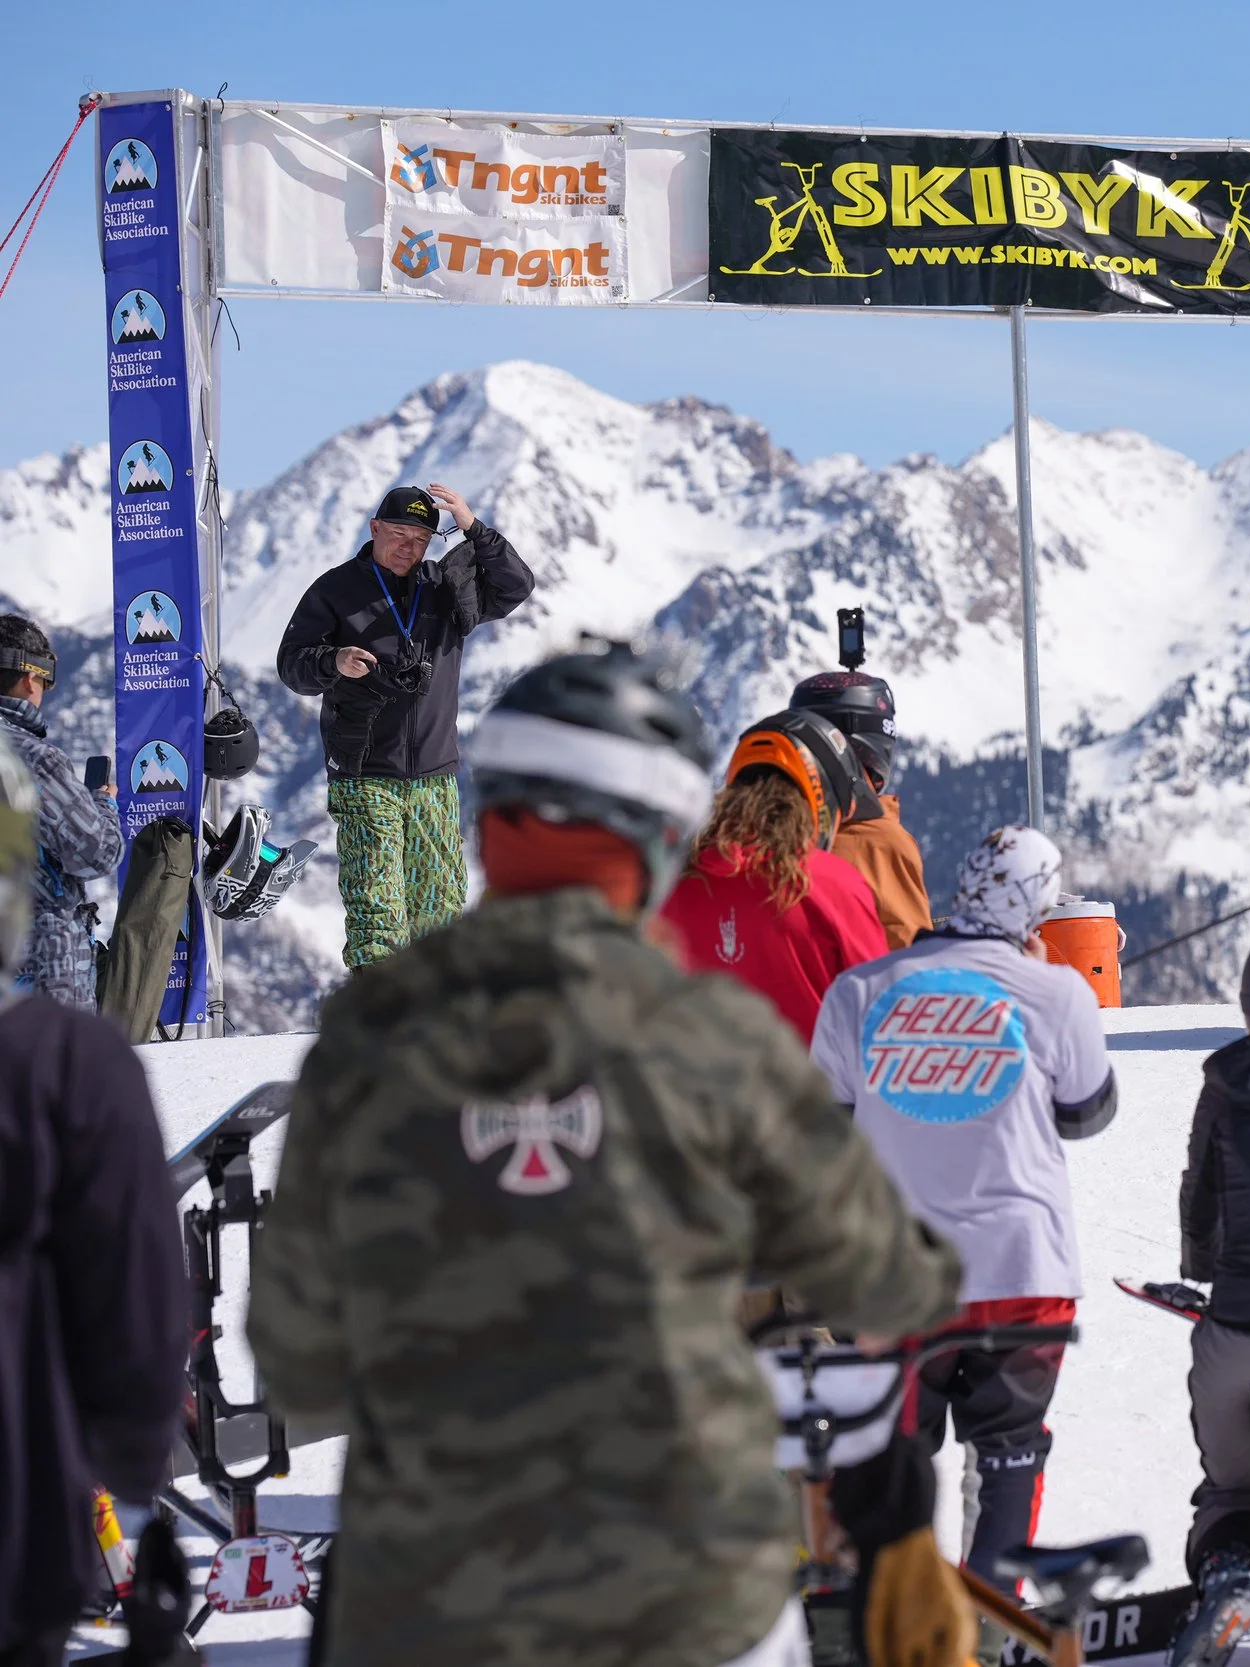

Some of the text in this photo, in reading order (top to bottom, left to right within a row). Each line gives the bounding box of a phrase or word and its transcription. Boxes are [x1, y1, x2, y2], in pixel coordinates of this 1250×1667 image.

[433, 148, 606, 204] Tngnt
[104, 198, 154, 213] American
[540, 194, 606, 205] ski bikes
[831, 162, 1216, 239] SKIBYK
[104, 212, 145, 227] SkiBike
[105, 224, 168, 241] Association
[438, 233, 609, 287] Tngnt
[886, 245, 1157, 276] WWW.SKIBYK.COM
[550, 275, 609, 287] ski bikes
[110, 349, 162, 364] American
[110, 363, 152, 378] SkiBike
[111, 375, 176, 392] Association
[116, 500, 170, 514] American
[117, 513, 161, 528] SkiBike
[118, 526, 184, 542] Association
[123, 650, 179, 664] American
[123, 663, 170, 678] SkiBike
[124, 676, 190, 691] Association
[126, 799, 185, 813] American
[874, 993, 1012, 1042] HELLA
[867, 1045, 1022, 1094] TIGHT
